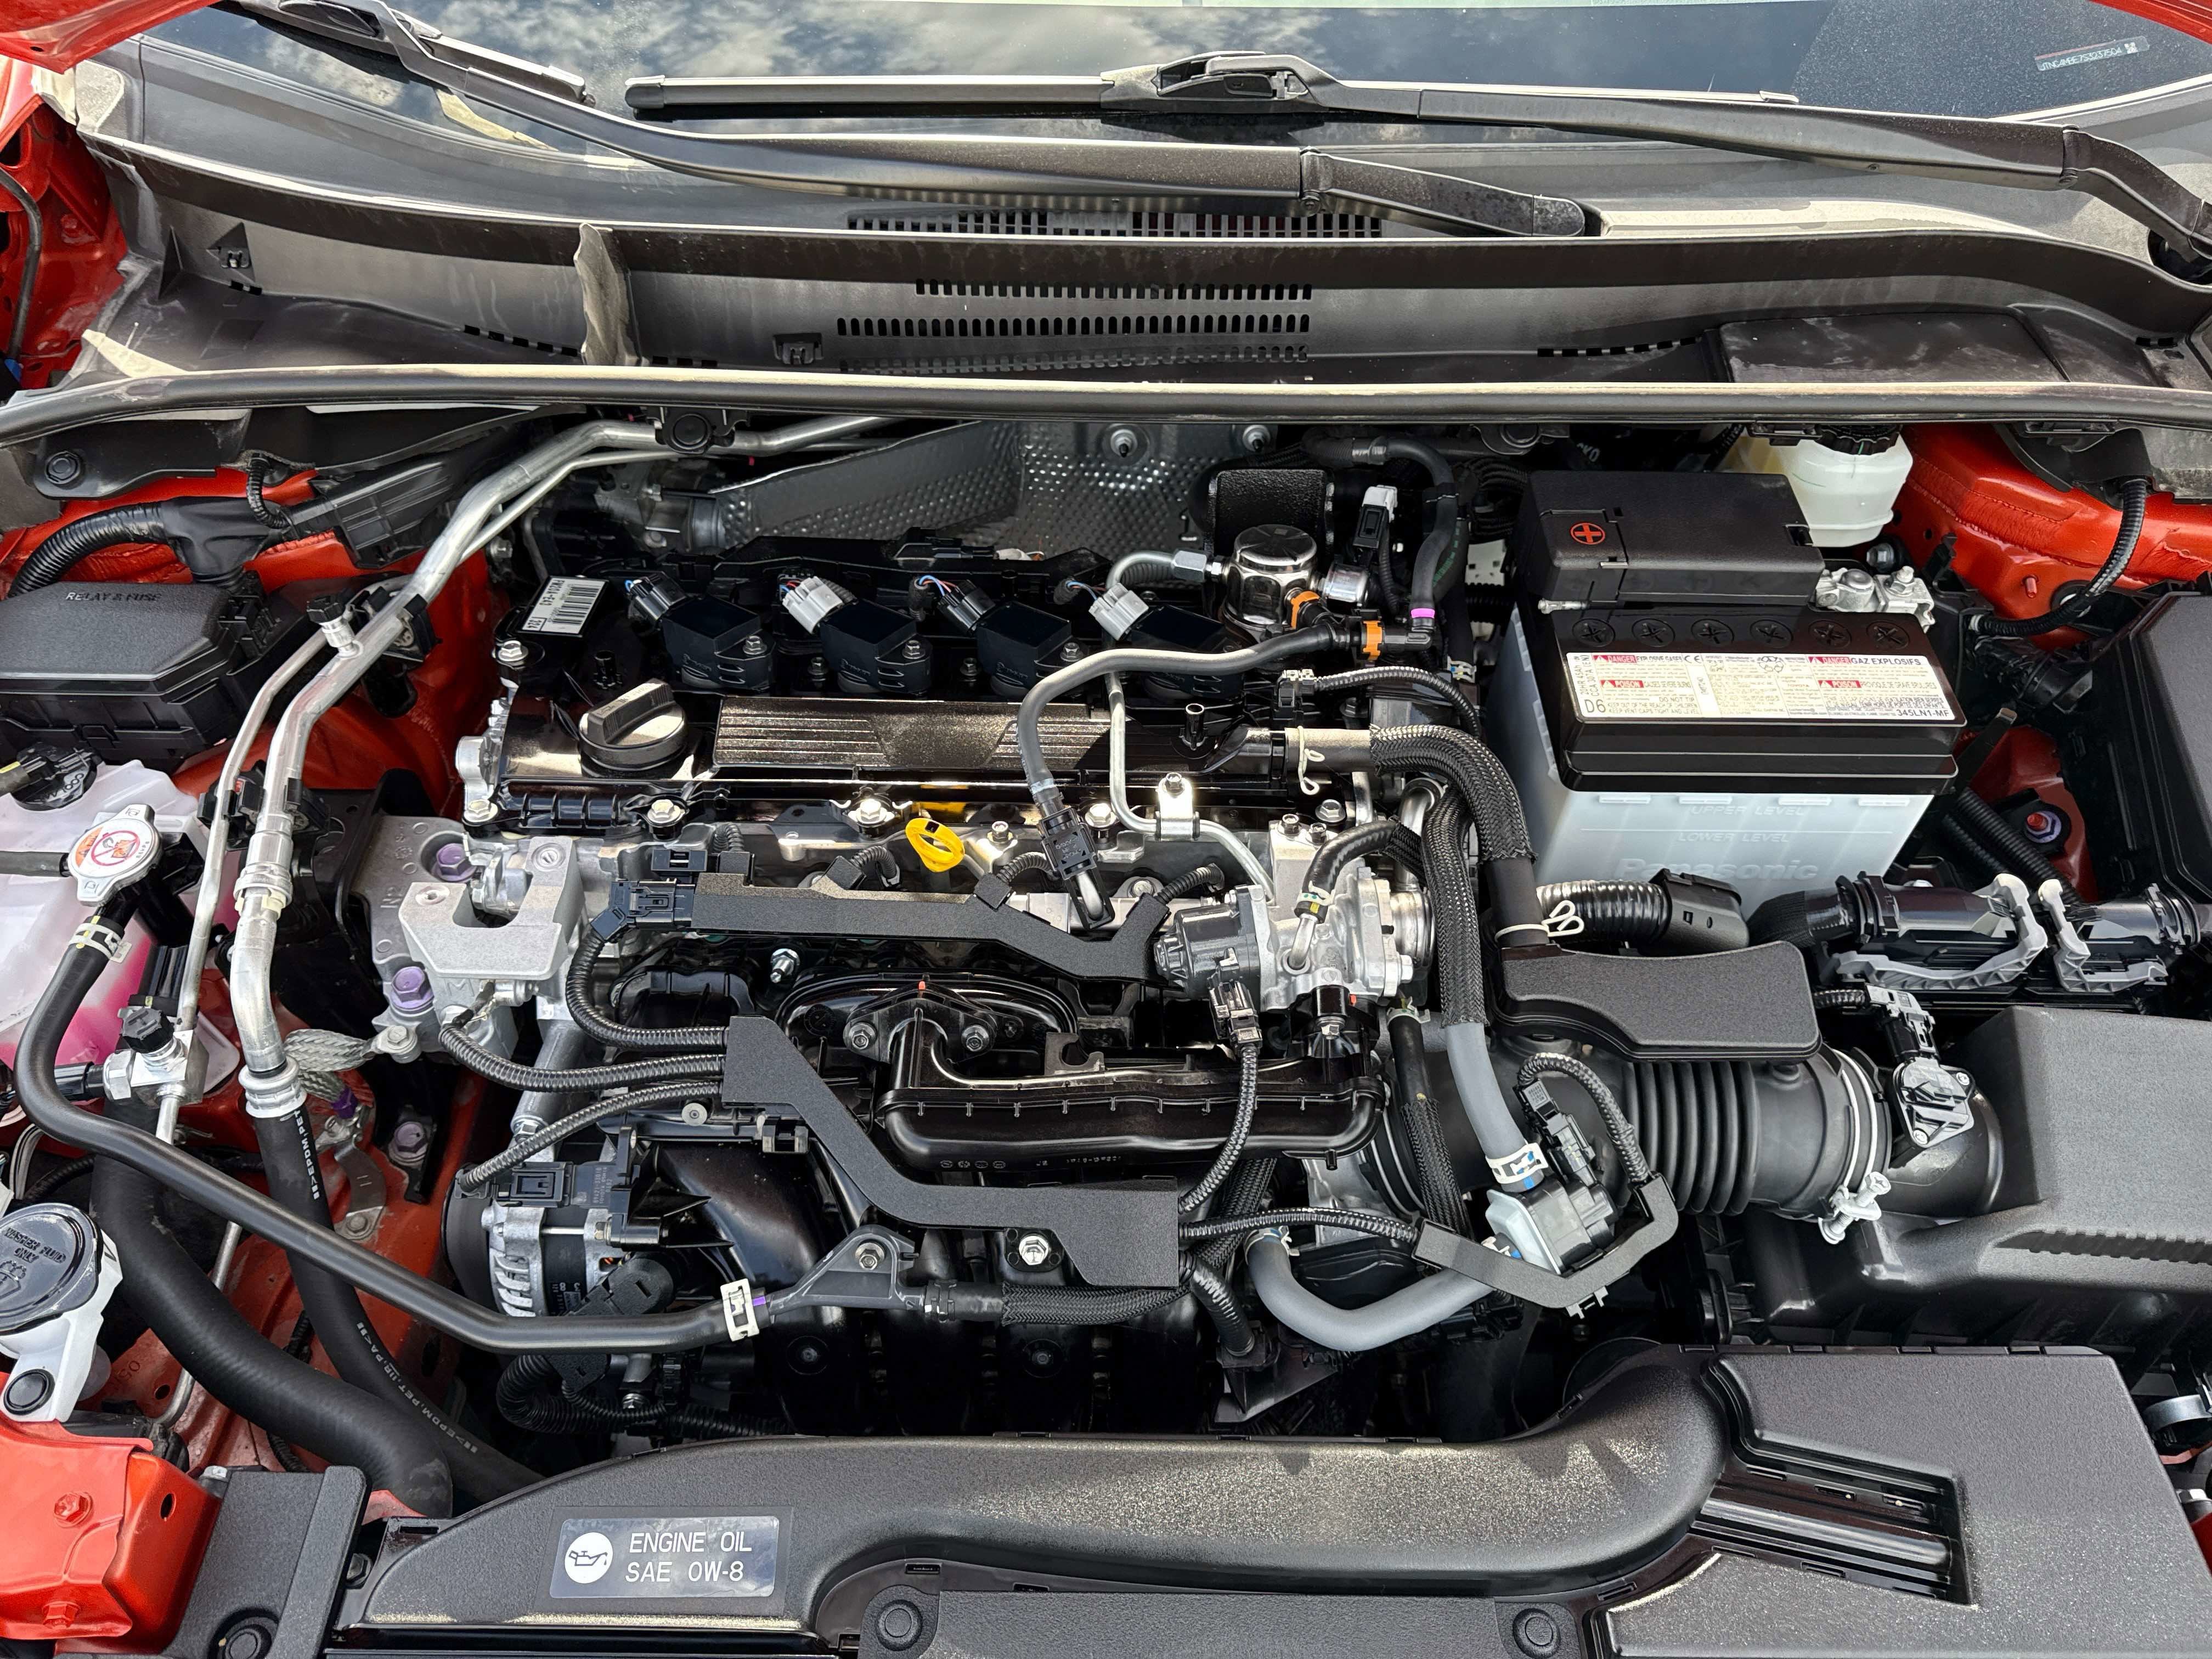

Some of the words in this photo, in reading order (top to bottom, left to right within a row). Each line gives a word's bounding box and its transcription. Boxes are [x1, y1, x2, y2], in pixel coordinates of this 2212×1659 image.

[66, 592, 111, 601] RELAY
[1584, 698, 1606, 714] D6
[1691, 805, 1746, 815] UPPER
[1754, 806, 1804, 816] LEVEL
[1678, 832, 1734, 842] LOWER
[1742, 833, 1790, 843] LEVEL
[1614, 858, 1818, 879] Panasonic
[5, 1227, 41, 1251] WASHER
[39, 1245, 67, 1264] FLUID
[14, 1246, 40, 1263] ONLY
[629, 1532, 706, 1553] ENGINE
[720, 1531, 752, 1552] OIL
[625, 1561, 672, 1583] SAE
[687, 1560, 744, 1582] 0W-8
